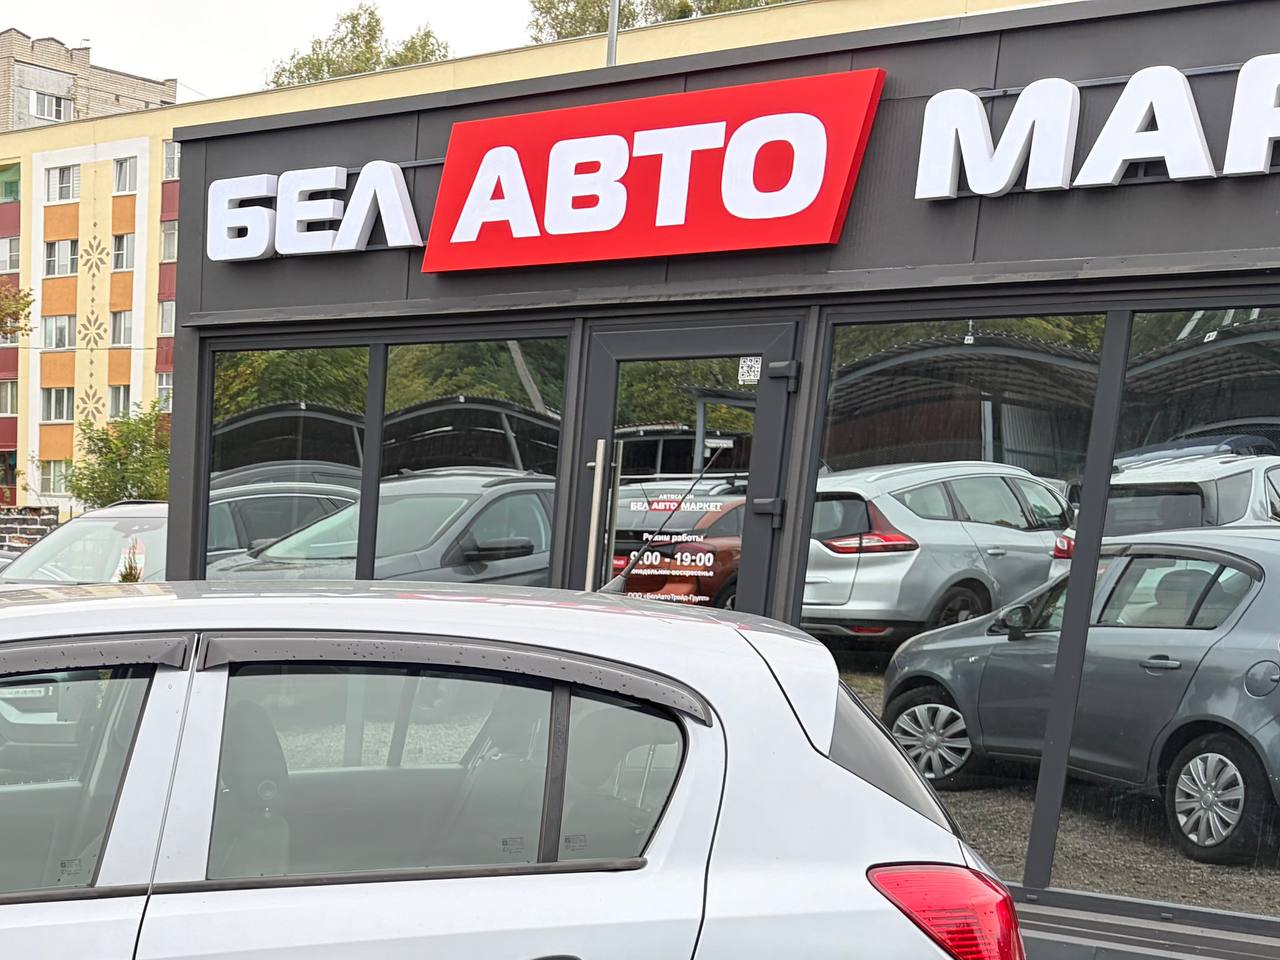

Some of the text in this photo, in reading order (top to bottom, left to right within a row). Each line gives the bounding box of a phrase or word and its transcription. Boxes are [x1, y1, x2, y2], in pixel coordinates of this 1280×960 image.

[207, 160, 425, 262] БЕЛ
[450, 112, 828, 244] АВТО
[631, 502, 723, 512] БЕЛ АВТО МАРКЕТ
[672, 533, 704, 543] работы
[674, 552, 714, 567] 19:00
[629, 568, 714, 577] онедельник-воскресенье
